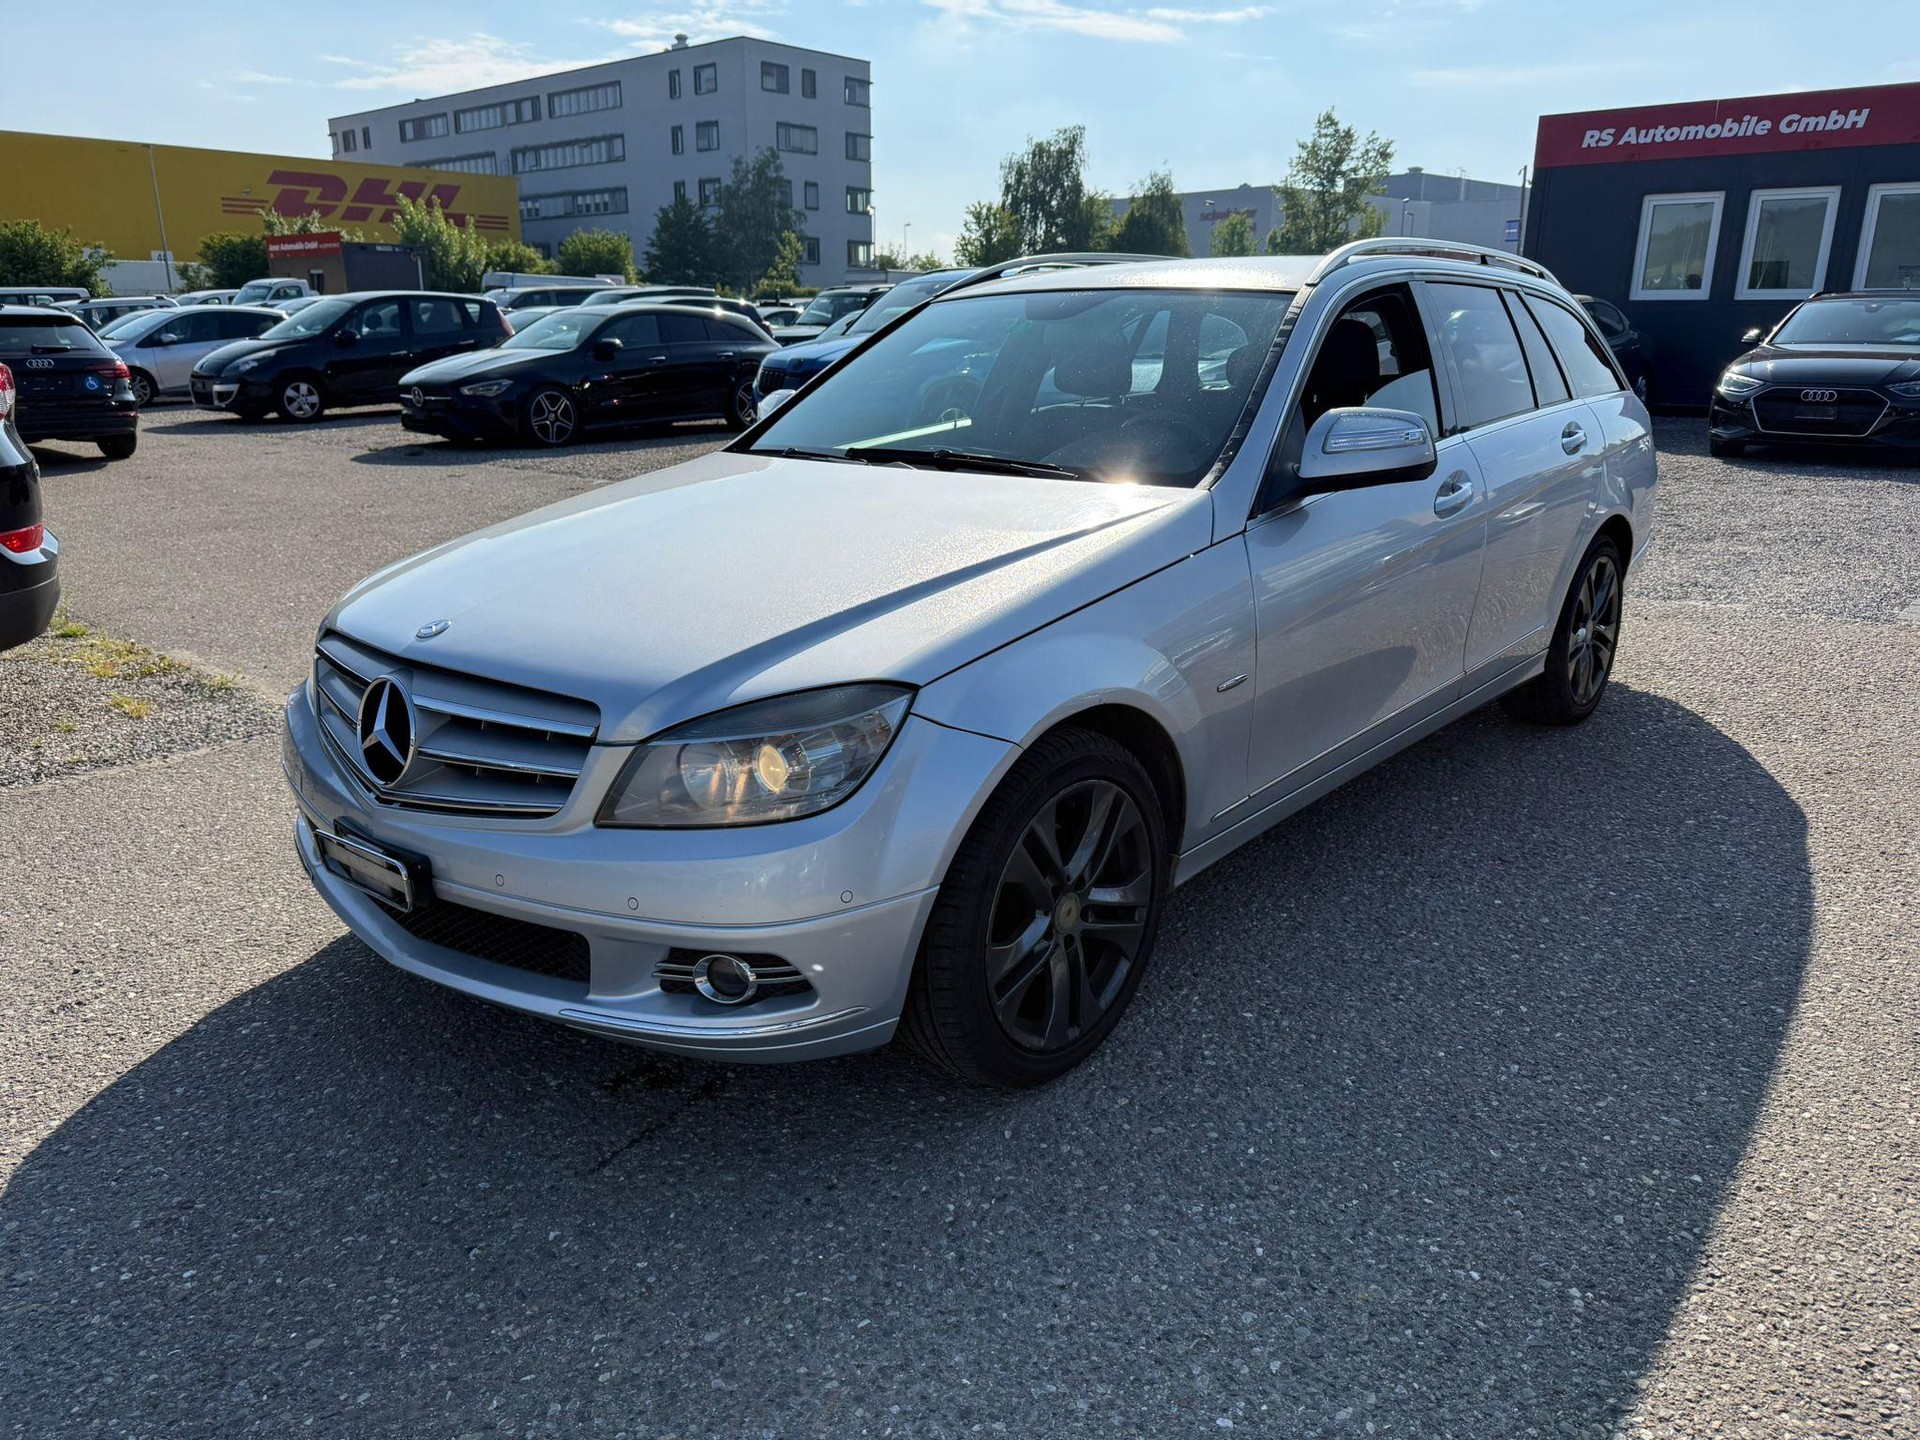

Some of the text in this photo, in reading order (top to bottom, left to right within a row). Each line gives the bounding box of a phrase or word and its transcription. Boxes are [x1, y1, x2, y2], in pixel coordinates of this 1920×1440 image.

[1581, 108, 1870, 148] RS Automobile GmbH
[266, 170, 475, 227] DHL
